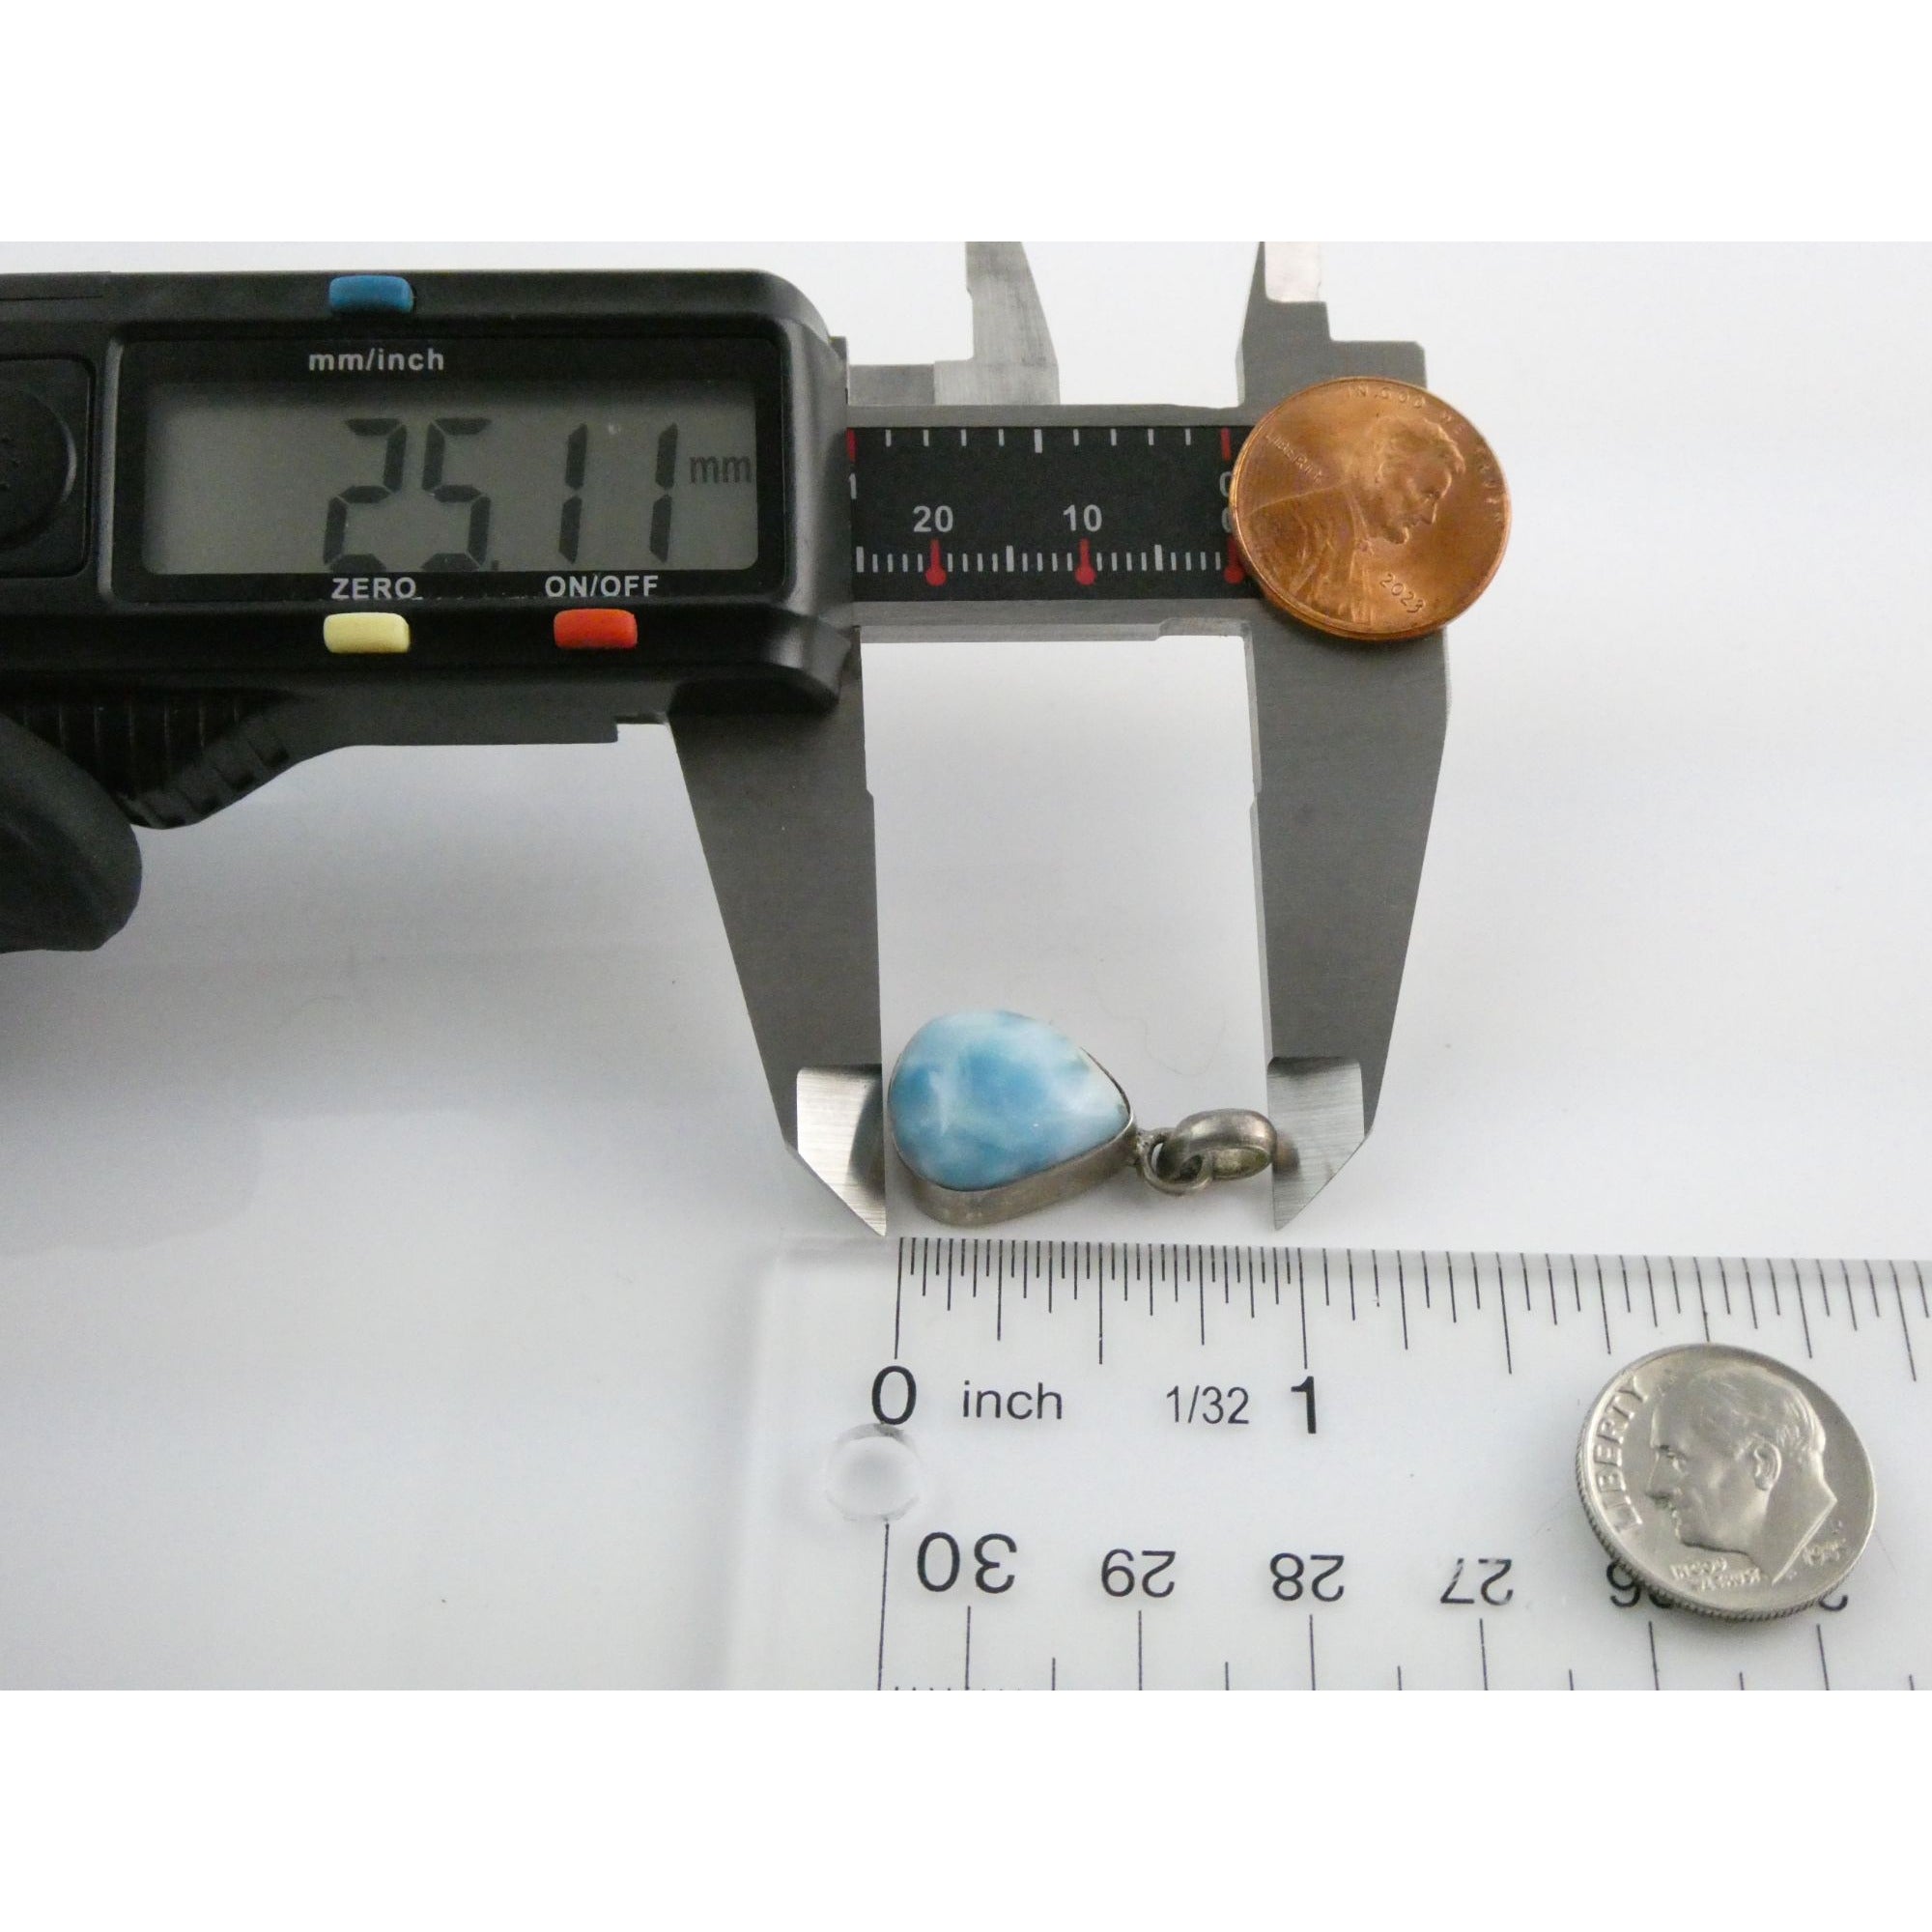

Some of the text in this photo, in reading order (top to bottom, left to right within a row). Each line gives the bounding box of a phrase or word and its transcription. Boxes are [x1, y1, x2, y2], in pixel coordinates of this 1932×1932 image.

[307, 348, 445, 371] mm/inch
[689, 455, 752, 484] mm
[912, 503, 1103, 533] 20 10
[330, 577, 417, 601] ZERO
[545, 574, 660, 599] ON/OFF
[1378, 572, 1426, 614] 2023
[870, 1364, 1317, 1435] 0 inch 1/32 1
[1594, 1374, 1648, 1532] LIBERTY
[916, 1531, 1018, 1595] 30
[1099, 1548, 1177, 1599] 29
[1268, 1552, 1346, 1603] 28
[1439, 1557, 1514, 1606] 27
